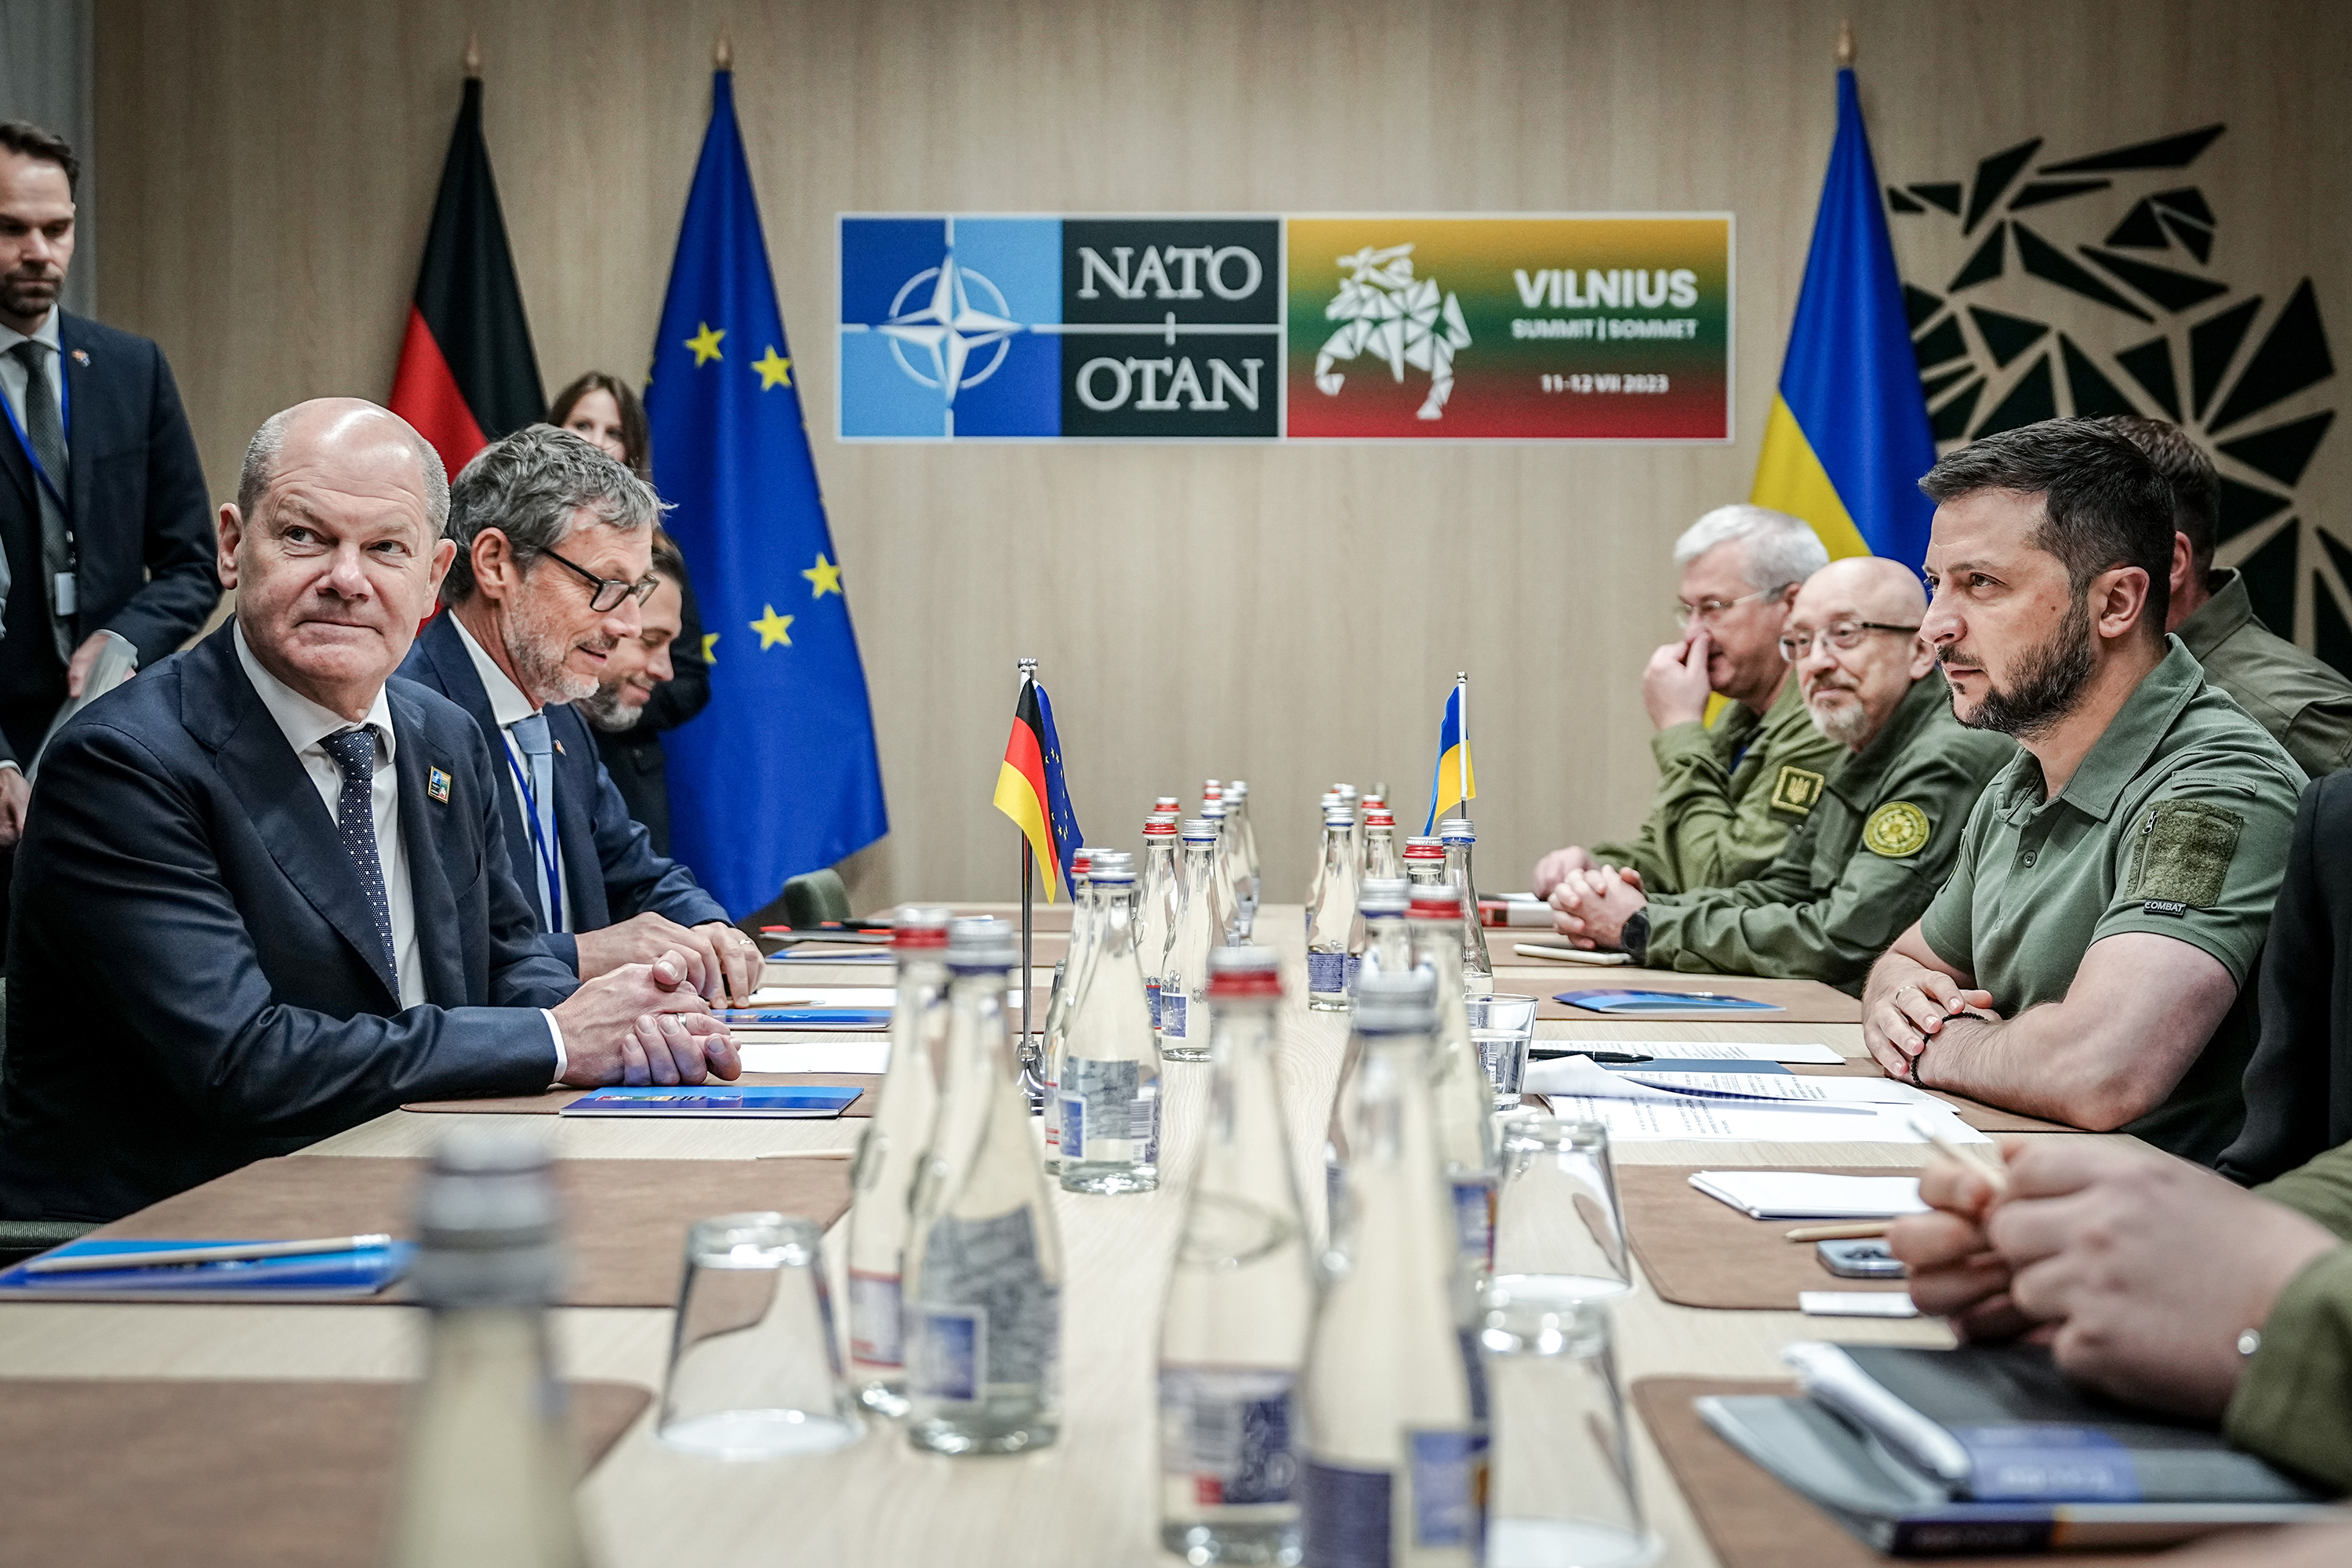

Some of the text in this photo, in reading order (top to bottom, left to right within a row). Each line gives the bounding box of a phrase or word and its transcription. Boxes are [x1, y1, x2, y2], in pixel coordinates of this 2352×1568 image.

[1076, 245, 1263, 301] NATO
[1513, 268, 1698, 309] VILNIUS
[1511, 318, 1594, 339] SUMMIT
[1608, 318, 1698, 339] SOMMET
[1075, 356, 1265, 412] OTAN
[1541, 374, 1593, 394] 11-12
[1622, 373, 1670, 394] 2023
[2144, 901, 2187, 913] COMBAT
